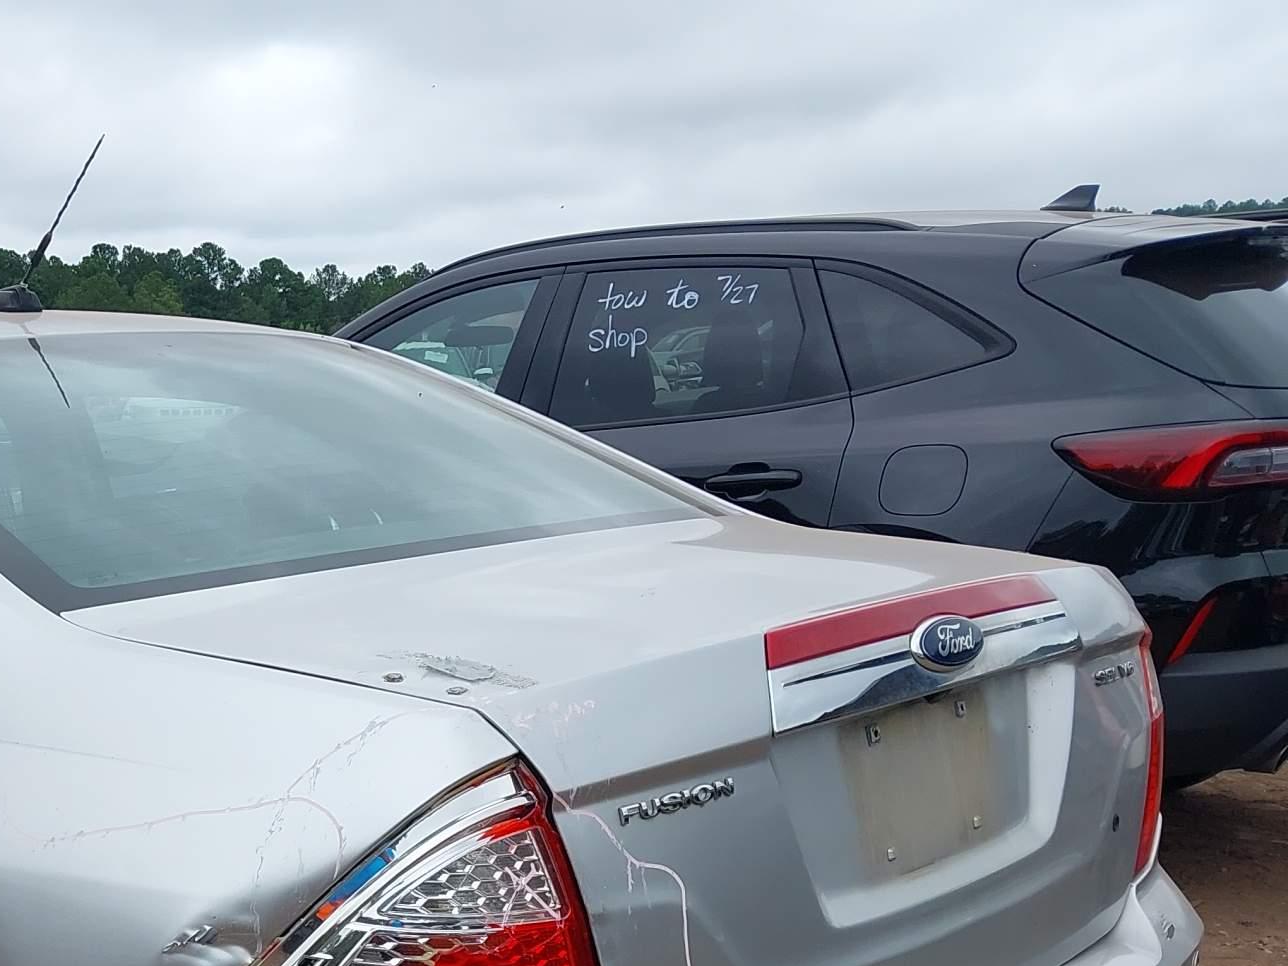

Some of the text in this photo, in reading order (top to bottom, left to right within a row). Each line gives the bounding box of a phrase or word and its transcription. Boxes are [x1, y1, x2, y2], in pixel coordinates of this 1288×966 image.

[598, 273, 759, 310] tow to 7/27
[588, 314, 648, 358] shop
[937, 622, 976, 657] Ford
[618, 777, 735, 826] FUSION
